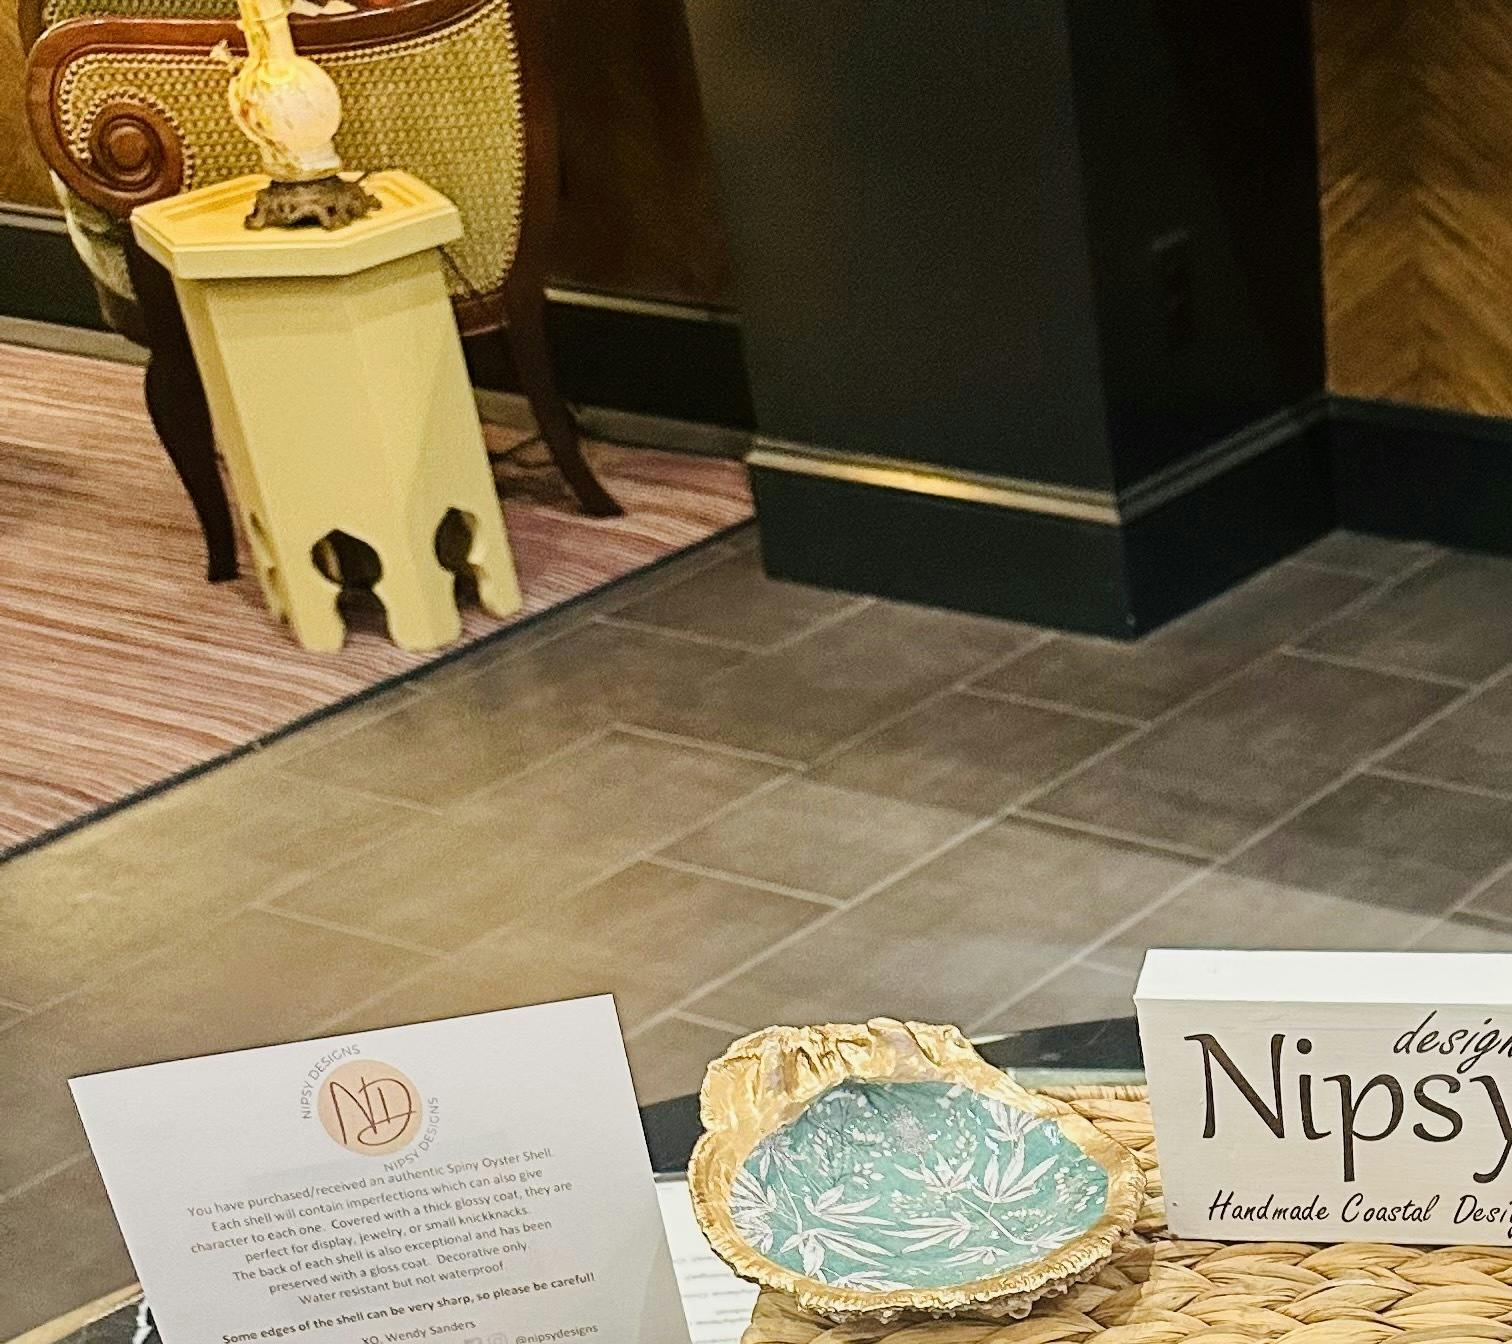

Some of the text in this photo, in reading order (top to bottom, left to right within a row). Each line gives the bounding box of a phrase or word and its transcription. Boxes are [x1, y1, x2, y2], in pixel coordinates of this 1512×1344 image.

[300, 1043, 361, 1120] NIPSY DESIGNS
[383, 1097, 440, 1173] NIPSY DESIGNS
[187, 1206, 213, 1218] You
[215, 1201, 245, 1214] have
[248, 1178, 367, 1210] purchased/received
[370, 1177, 385, 1187] an
[388, 1167, 444, 1184] authentic
[447, 1161, 479, 1175] Spiny
[482, 1155, 520, 1169] Oyster
[191, 1236, 249, 1254] character
[251, 1233, 265, 1244] to
[267, 1227, 297, 1241] each
[331, 1212, 381, 1230] Covered
[384, 1206, 411, 1221] with
[413, 1207, 421, 1216] a
[423, 1200, 451, 1214] thick
[455, 1194, 491, 1211] glossy
[493, 1188, 522, 1203] coat,
[525, 1184, 551, 1199] they
[554, 1181, 573, 1192] are
[211, 1168, 543, 1232] Each shell will contain imperfections which can also give
[1208, 1189, 1330, 1225] Handmade
[1341, 1192, 1441, 1225] Coastal
[232, 1219, 552, 1282] The back of each shell is also exceptional and has been
[245, 1246, 289, 1264] perfect
[292, 1242, 309, 1254] for
[359, 1228, 407, 1246] jewelry,
[409, 1225, 422, 1234] or
[425, 1217, 456, 1231] small
[268, 1273, 328, 1295] preserved
[330, 1270, 357, 1284] with
[359, 1269, 367, 1279] a
[369, 1262, 399, 1280] gloss
[436, 1245, 500, 1265] Decorative
[222, 1332, 258, 1344] Some
[260, 1325, 296, 1340] edges
[298, 1320, 311, 1332] of
[313, 1316, 334, 1329] the
[336, 1311, 364, 1326] shell
[366, 1309, 387, 1321] can
[390, 1304, 405, 1317] be
[408, 1300, 435, 1314] very
[437, 1294, 475, 1309] sharp,
[476, 1292, 490, 1302] so
[493, 1283, 530, 1299] please
[533, 1279, 548, 1292] be
[298, 1291, 336, 1305] Water
[339, 1282, 389, 1299] resistant
[392, 1277, 413, 1290] but
[415, 1273, 437, 1285] not
[384, 1327, 427, 1343] Wendy
[429, 1319, 476, 1336] Sanders
